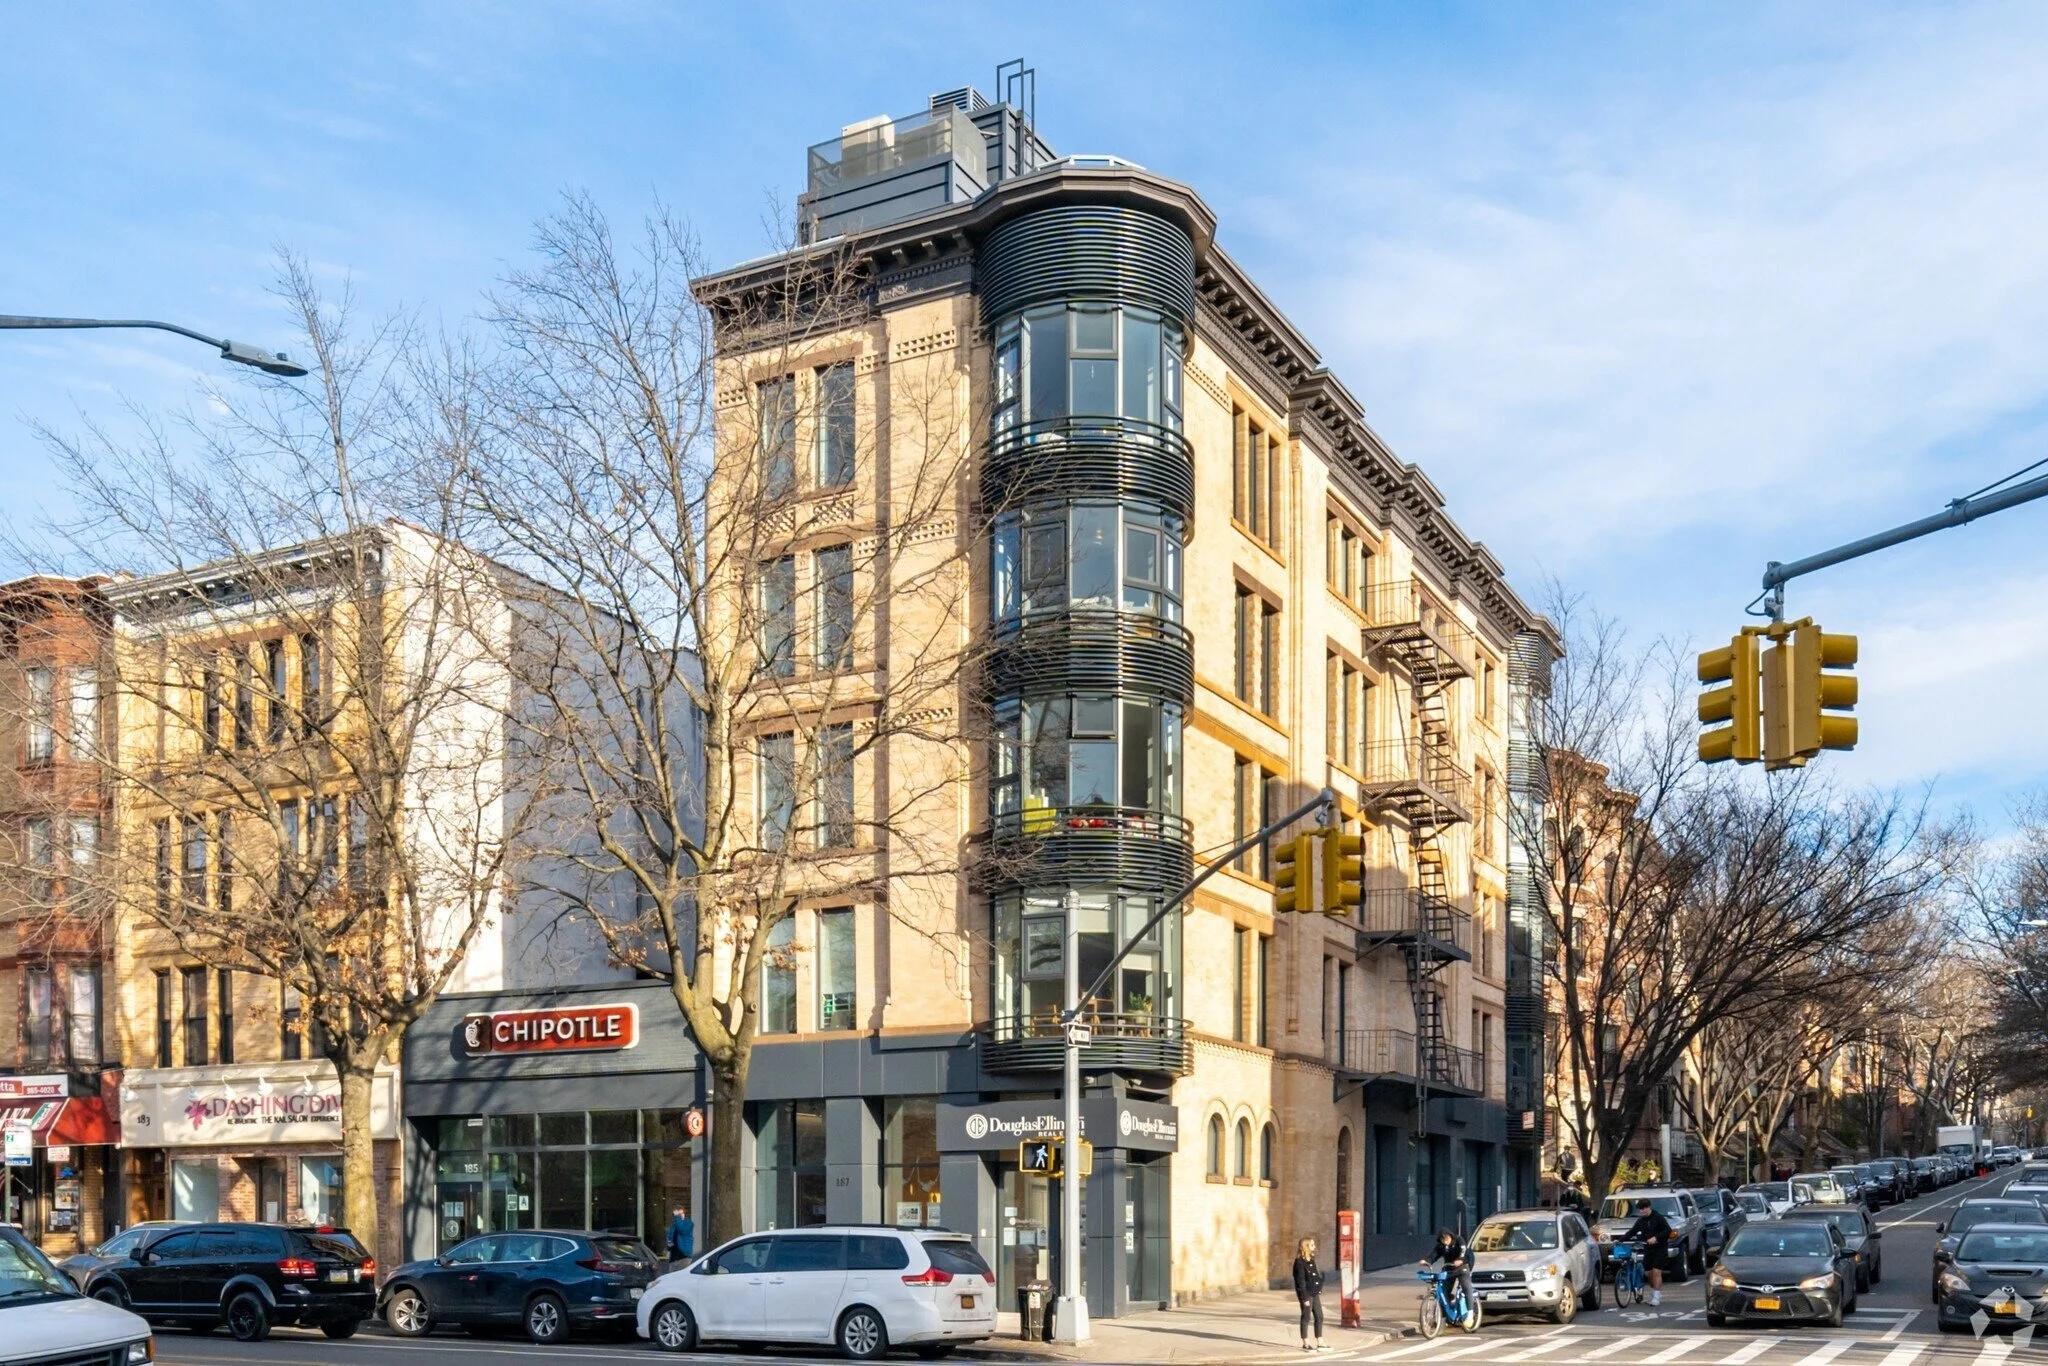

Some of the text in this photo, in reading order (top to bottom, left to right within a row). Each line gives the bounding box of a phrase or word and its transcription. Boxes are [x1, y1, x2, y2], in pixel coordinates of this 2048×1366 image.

[495, 1014, 621, 1043] CHIPOTLE
[213, 1095, 304, 1117] DASHING
[137, 1114, 151, 1126] 183
[261, 1116, 273, 1124] THE
[287, 1115, 309, 1123] SALON
[464, 1163, 479, 1173] 185
[836, 1177, 850, 1187] 187
